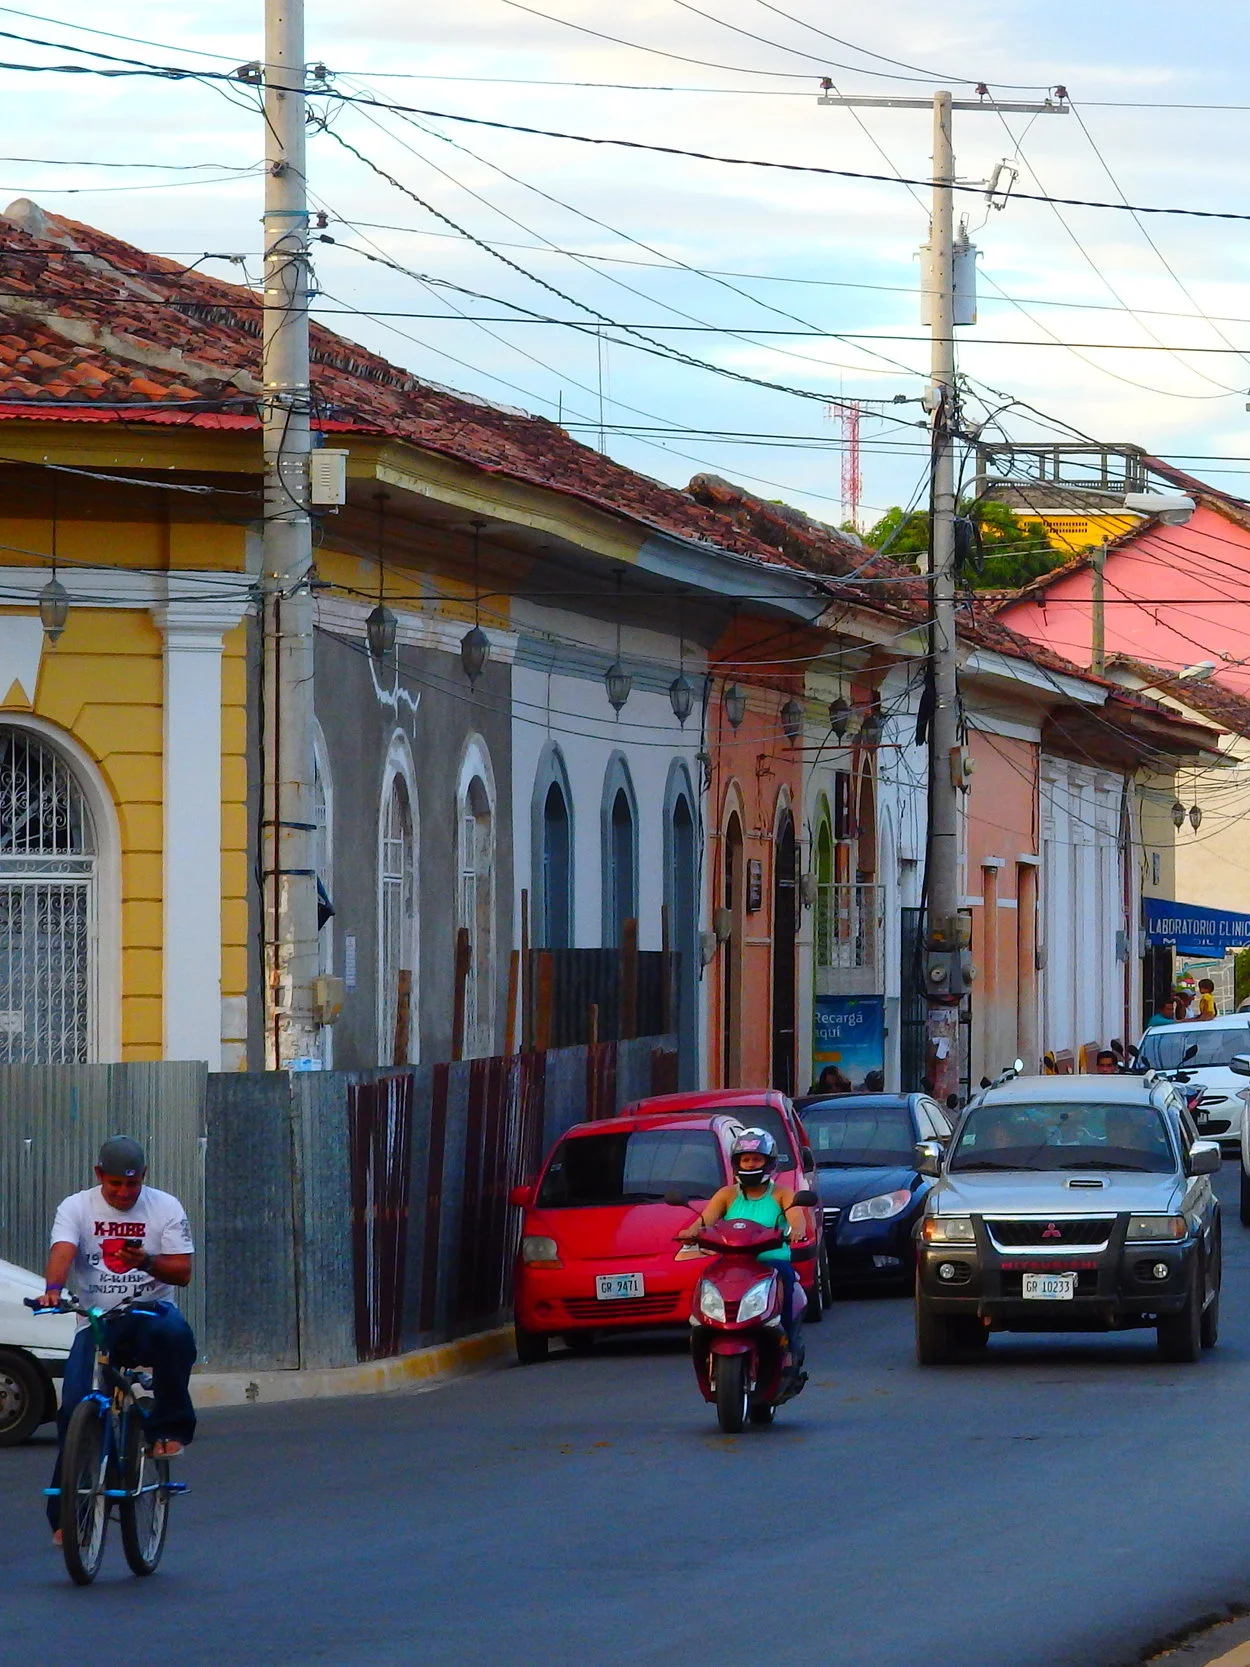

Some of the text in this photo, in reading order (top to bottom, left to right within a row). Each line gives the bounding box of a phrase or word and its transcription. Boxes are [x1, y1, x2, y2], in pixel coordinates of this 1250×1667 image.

[1149, 918, 1216, 936] LABORATORIO
[815, 1010, 863, 1027] Recargá
[601, 1280, 639, 1293] GR 9471
[1026, 1281, 1070, 1293] GR 10233
